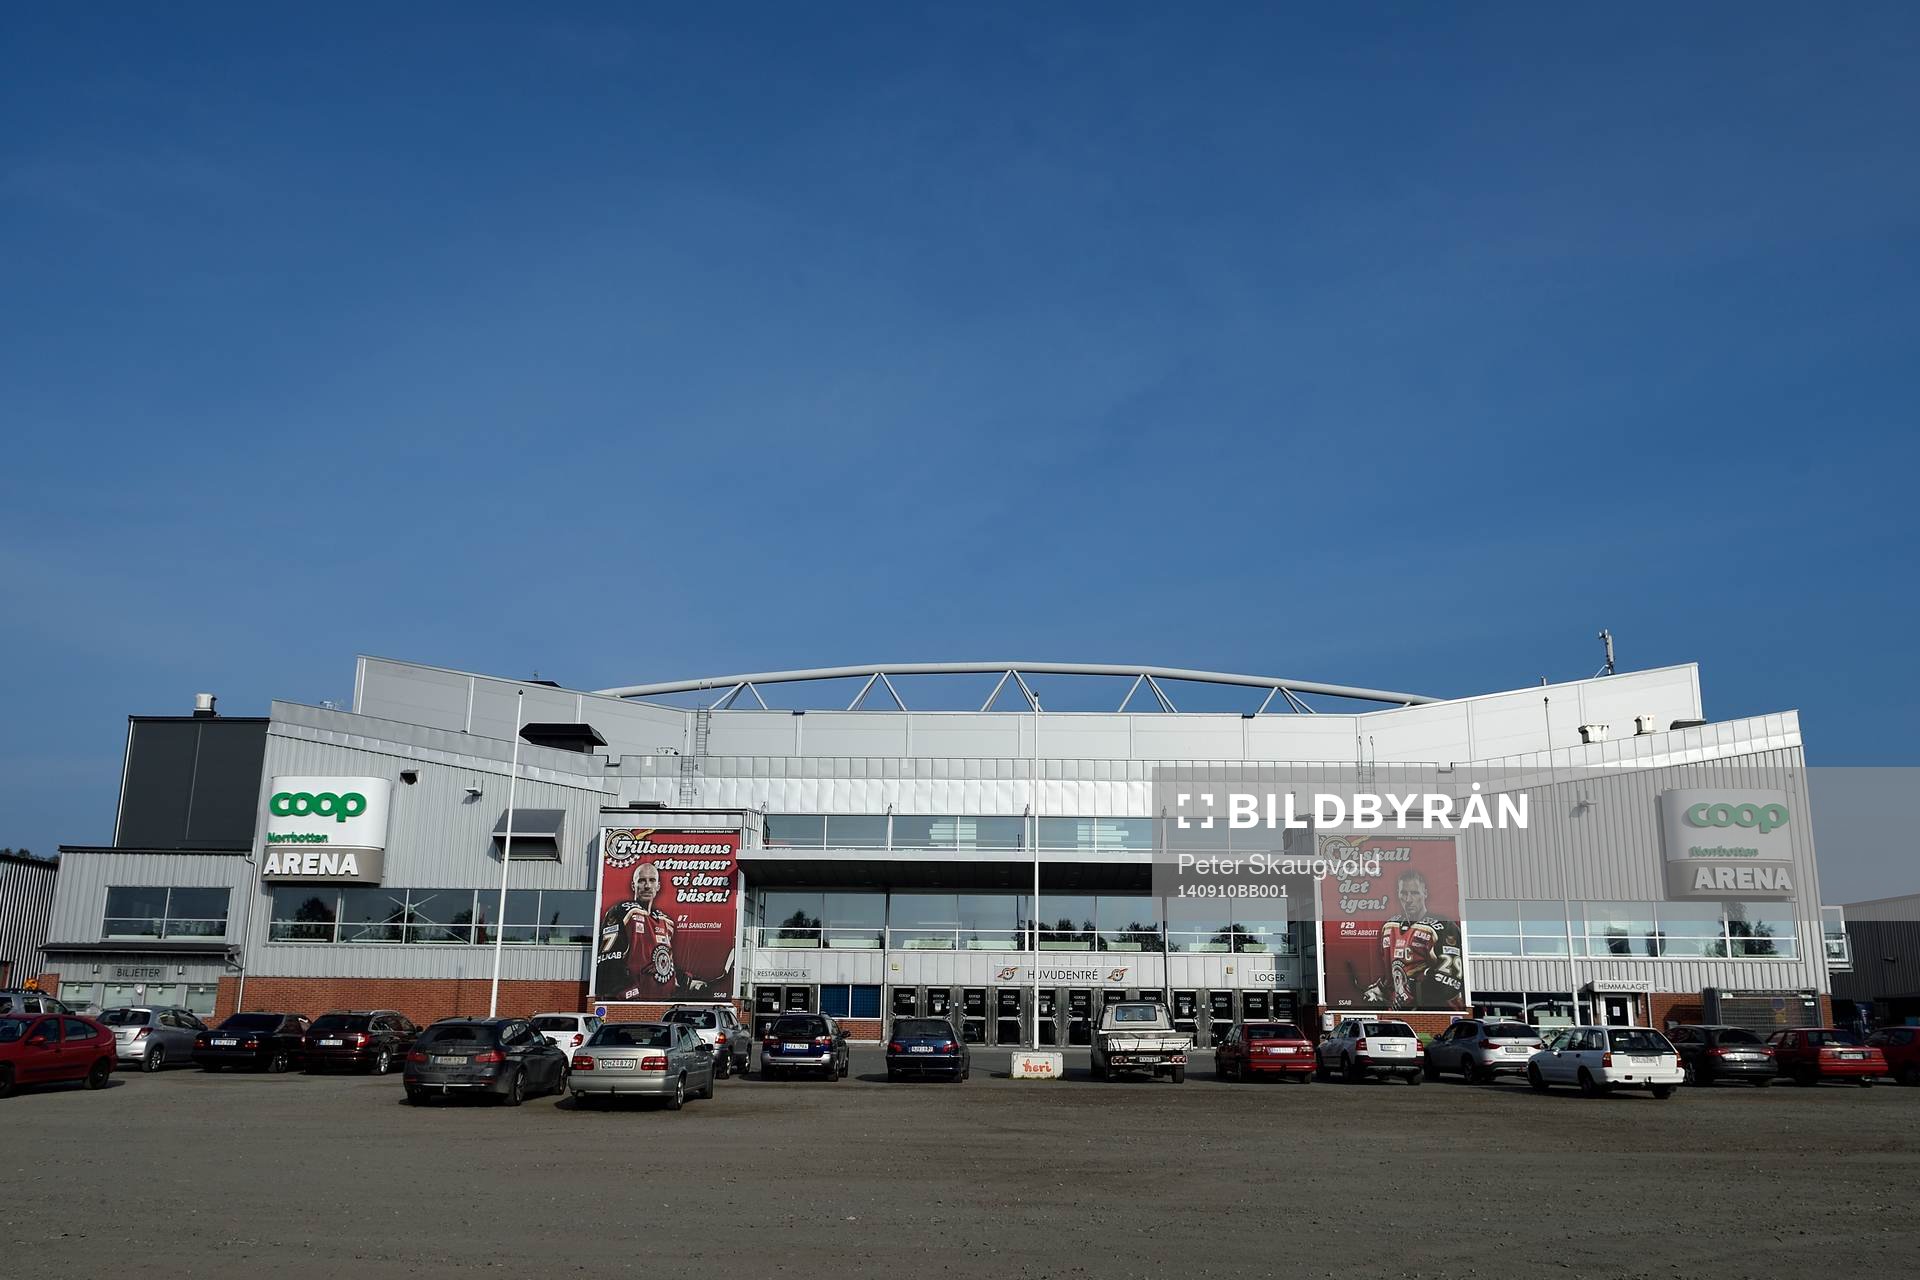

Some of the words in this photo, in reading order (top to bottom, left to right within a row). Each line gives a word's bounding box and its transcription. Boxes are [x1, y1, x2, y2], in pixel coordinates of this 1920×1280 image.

[270, 792, 367, 823] coop
[1687, 803, 1790, 834] coop
[267, 832, 329, 844] Norrbotten
[618, 840, 731, 855] Tillsammans
[1339, 847, 1360, 861] Vi
[1363, 847, 1411, 861] skall
[263, 853, 359, 877] ARENA
[653, 858, 731, 870] utmanar
[672, 873, 691, 886] vi
[692, 873, 730, 887] dom
[1694, 866, 1793, 890] ARENA
[1339, 879, 1370, 893] det
[677, 889, 730, 903] bästa!
[1339, 896, 1388, 914] igen!
[1340, 921, 1356, 929] #29
[601, 932, 619, 953] 7
[1404, 947, 1412, 961] C
[116, 968, 161, 977] BILJETTER
[757, 970, 799, 978] RESTAURANG
[1254, 973, 1286, 982] LOGER
[1598, 983, 1650, 991] HEMMALAGET
[1023, 1058, 1052, 1073] heri
